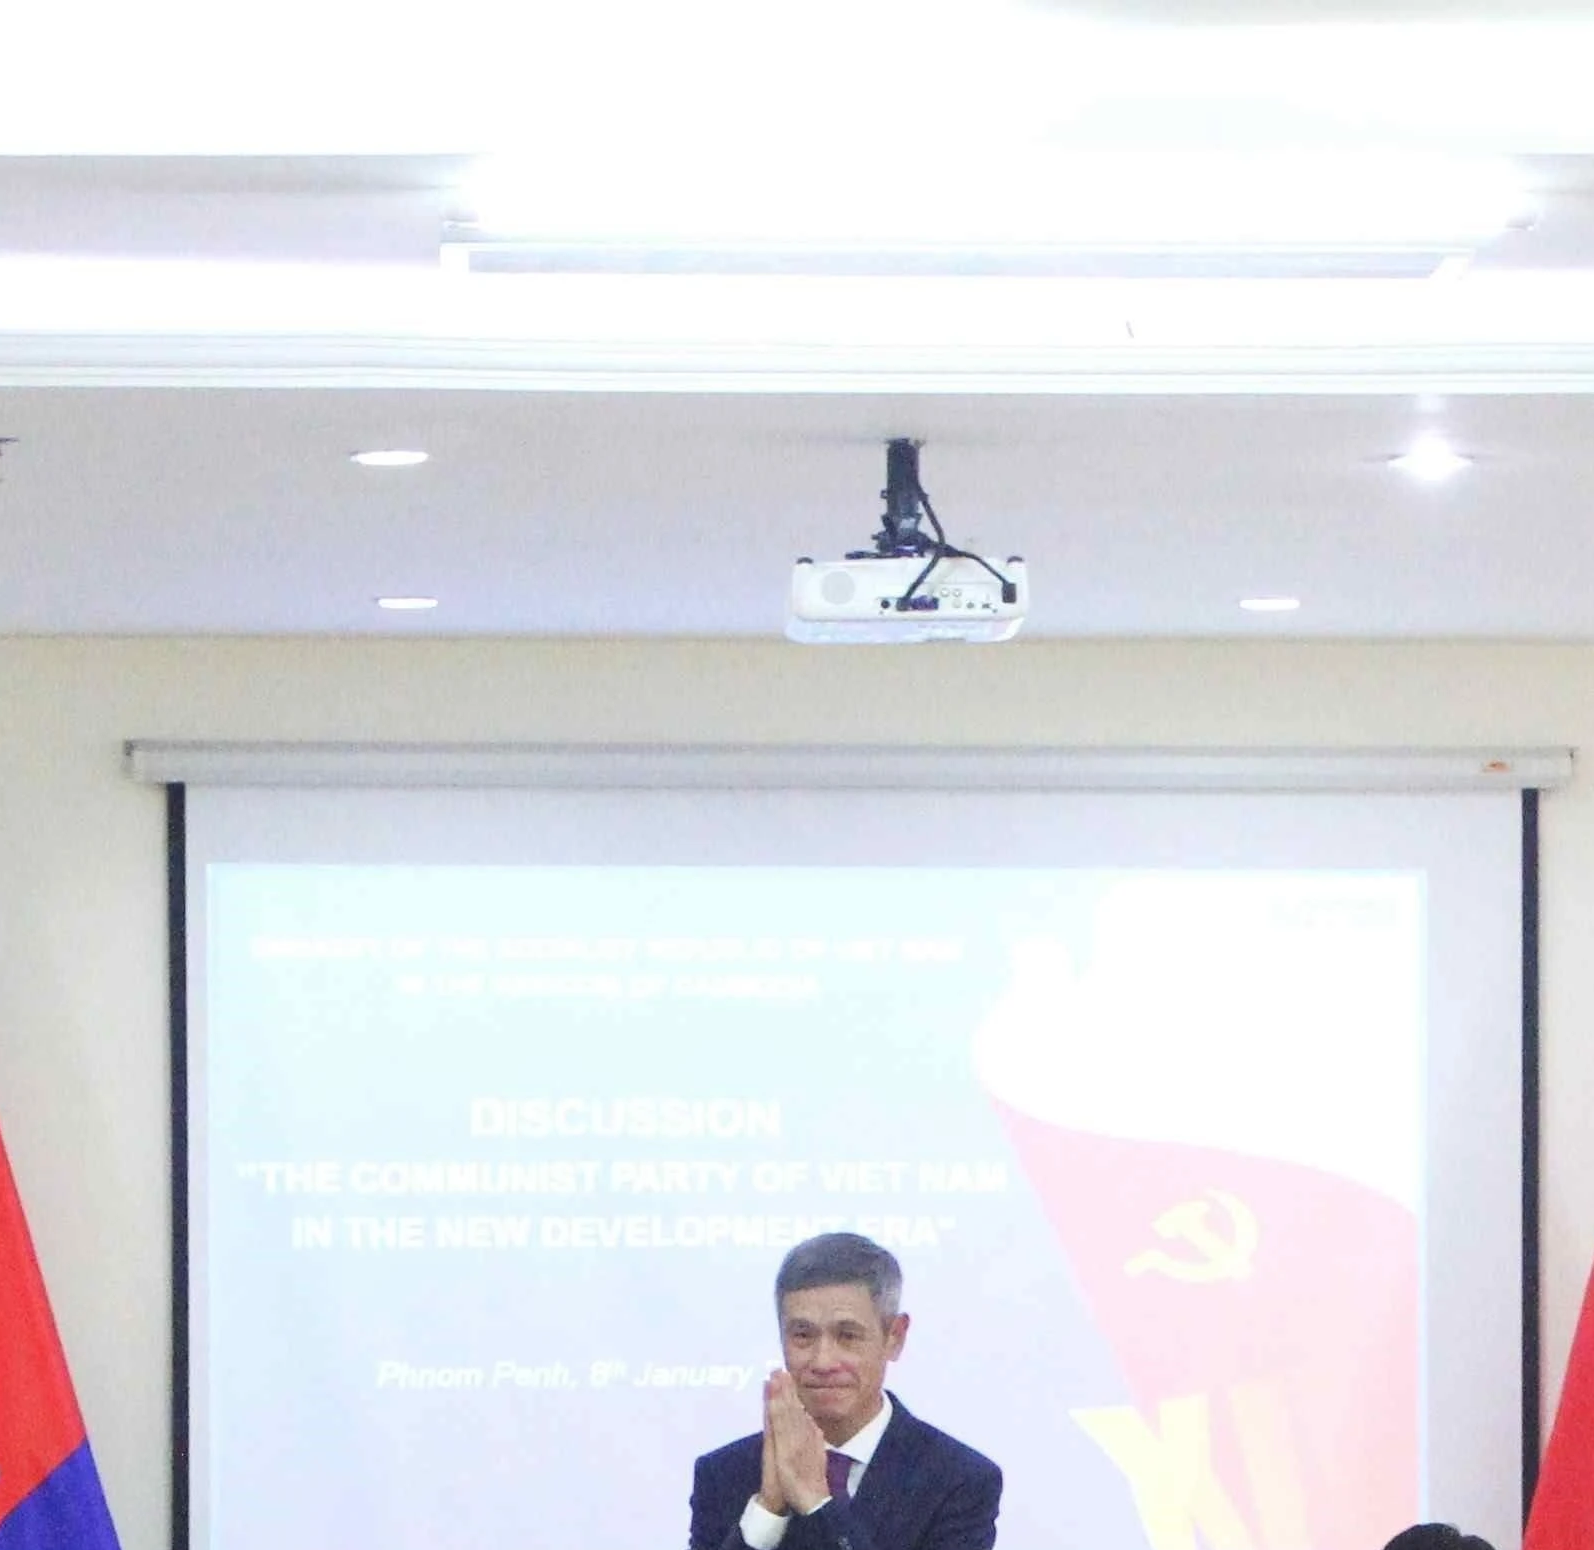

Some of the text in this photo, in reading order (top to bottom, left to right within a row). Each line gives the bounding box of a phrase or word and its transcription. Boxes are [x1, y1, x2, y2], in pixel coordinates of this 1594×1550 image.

[469, 1097, 782, 1138] DISCUSSION
[351, 1160, 599, 1193] COMMUNIST
[611, 1160, 738, 1193] PARTY
[751, 1160, 811, 1193] OF
[820, 1160, 909, 1193] VIET
[919, 1160, 1009, 1193] NAM
[293, 1216, 333, 1249] IN
[346, 1216, 424, 1249] THE
[438, 1216, 533, 1249] NEW
[378, 1360, 483, 1388] Phnom
[493, 1360, 578, 1392] Penh,
[635, 1360, 754, 1392] January
